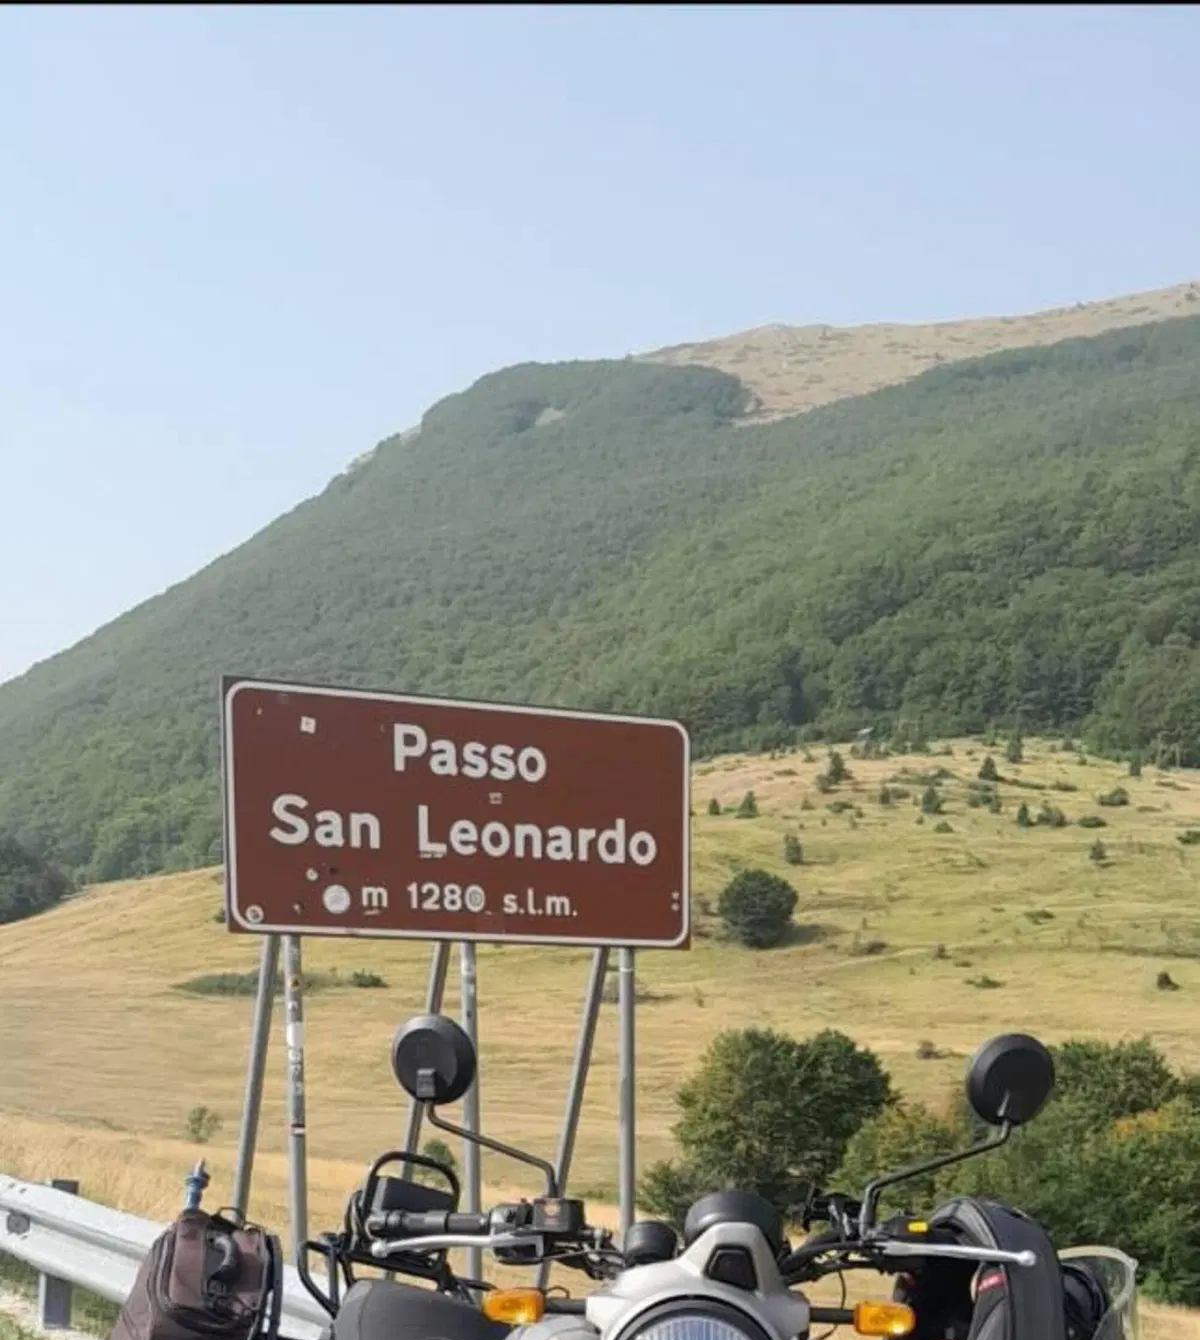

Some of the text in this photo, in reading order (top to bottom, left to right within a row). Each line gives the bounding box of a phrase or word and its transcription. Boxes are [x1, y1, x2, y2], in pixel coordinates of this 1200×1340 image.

[394, 723, 547, 782] Passo
[270, 794, 657, 865] San Leonardo
[361, 882, 578, 917] m 1280 s.l.m.
